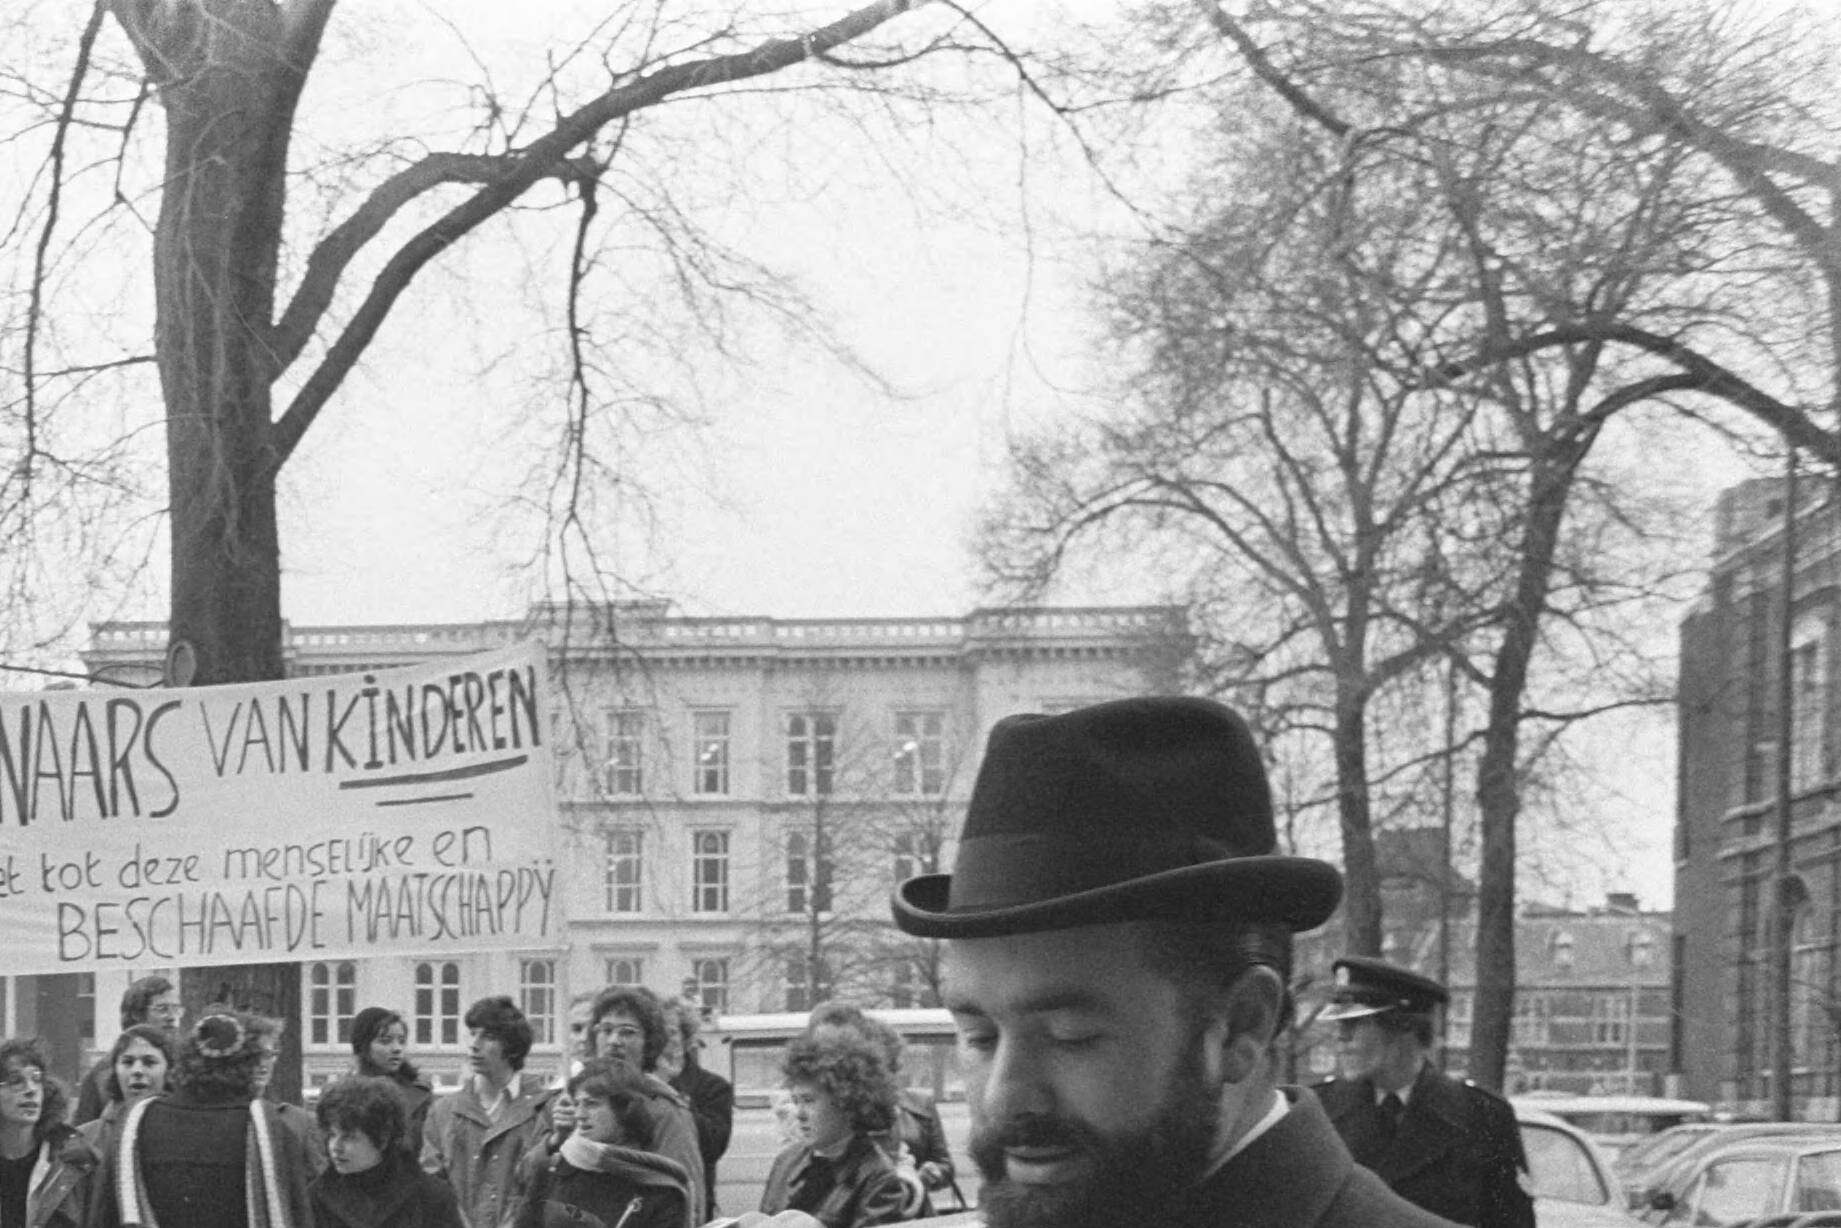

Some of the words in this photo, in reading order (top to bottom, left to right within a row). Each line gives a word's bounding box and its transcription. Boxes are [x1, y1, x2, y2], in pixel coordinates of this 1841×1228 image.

[200, 693, 309, 777] VAN
[325, 664, 542, 774] KINDEREN
[41, 850, 102, 892] tot
[118, 843, 200, 890] deze
[432, 825, 492, 868] en
[58, 880, 328, 962] BESCHAAFDE
